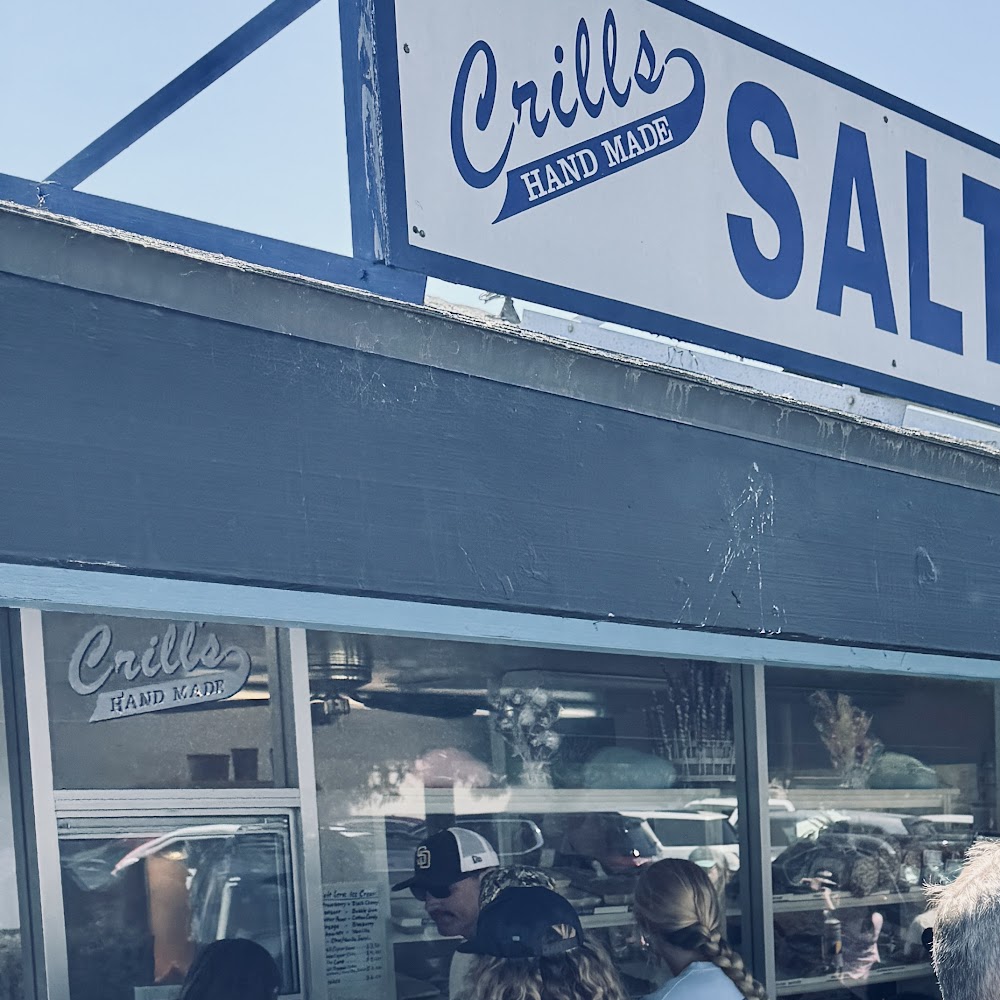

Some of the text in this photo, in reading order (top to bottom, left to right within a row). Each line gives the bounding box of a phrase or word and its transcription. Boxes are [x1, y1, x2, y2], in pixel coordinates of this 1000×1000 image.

[450, 7, 668, 188] Crills
[520, 115, 673, 202] HAND MADE
[110, 679, 225, 712] HAND MADE
